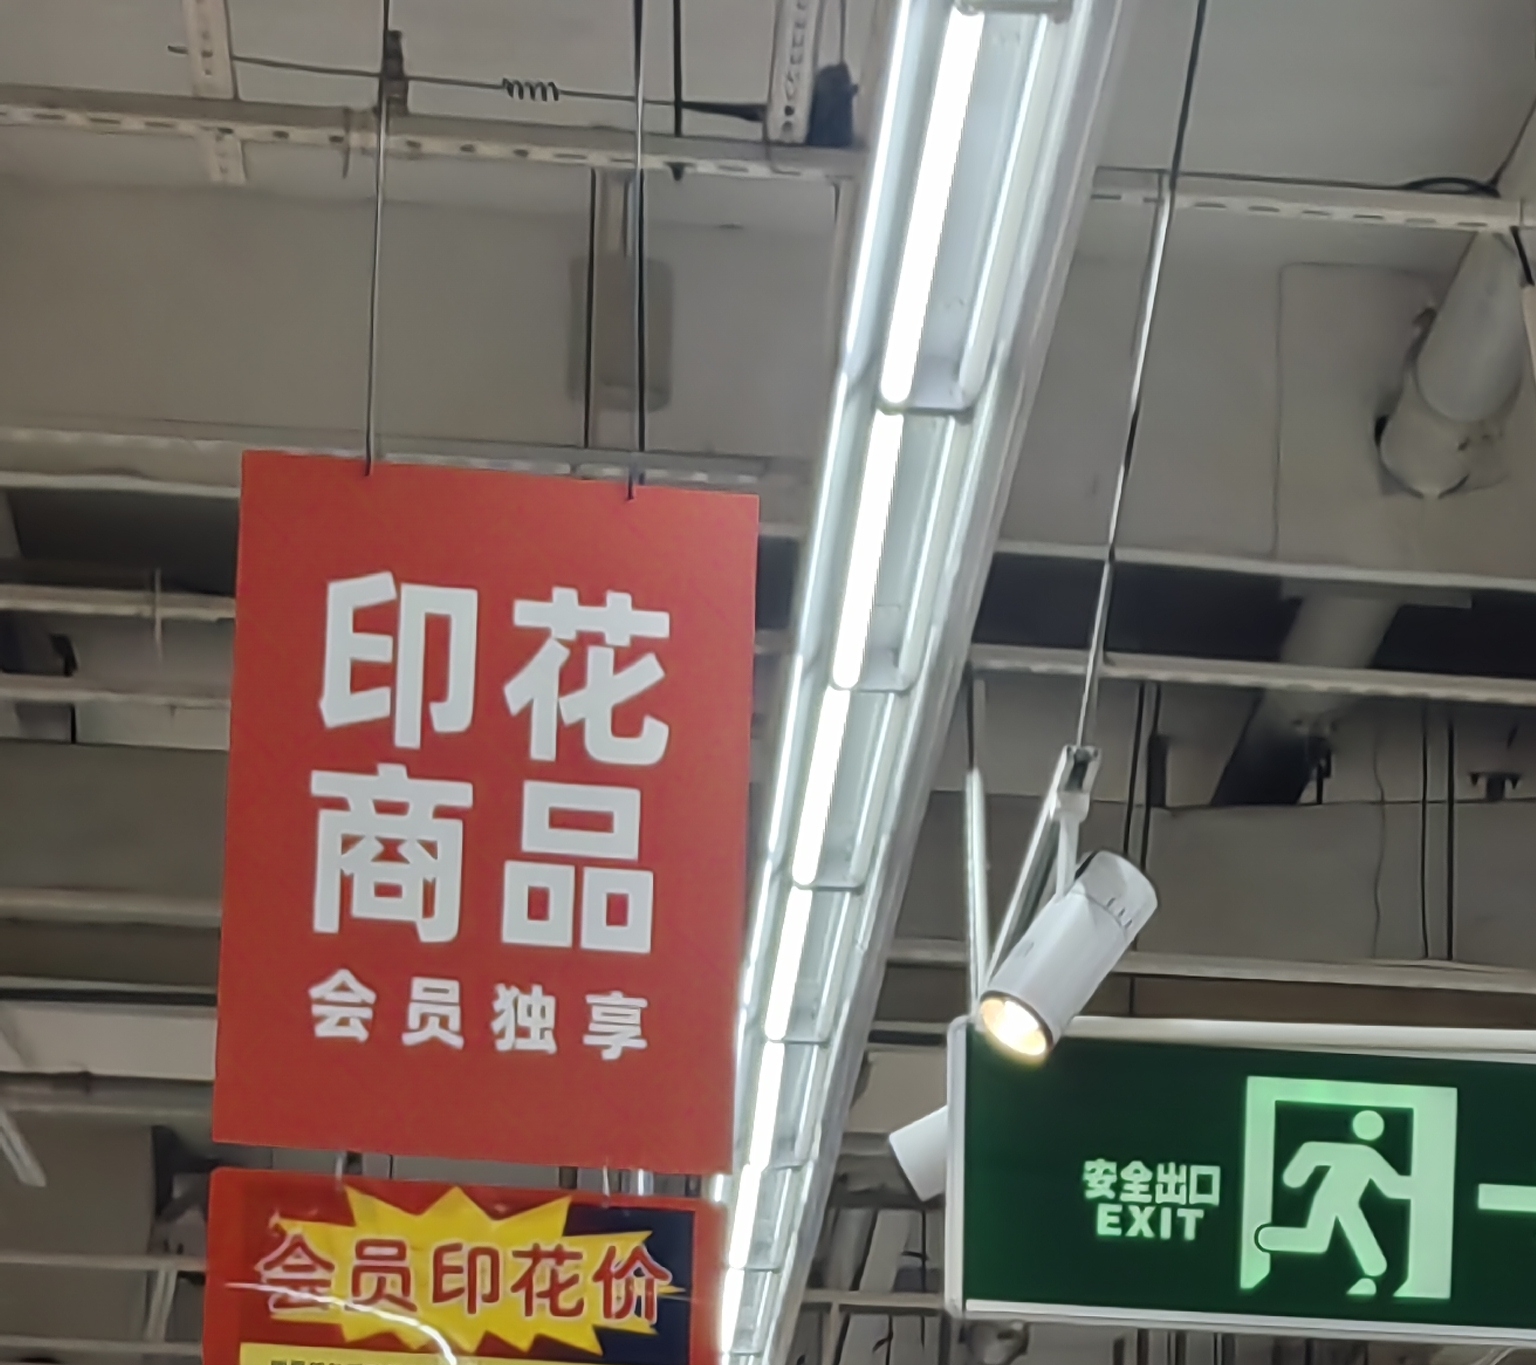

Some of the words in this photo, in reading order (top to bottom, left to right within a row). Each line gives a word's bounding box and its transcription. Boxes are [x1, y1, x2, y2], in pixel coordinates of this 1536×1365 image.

[319, 570, 672, 765] 印花
[308, 762, 655, 955] 商品
[307, 967, 649, 1062] 会员独享
[1082, 1158, 1221, 1208] 安全出口
[1095, 1203, 1205, 1242] EXIT
[255, 1229, 672, 1324] 会员印花价
